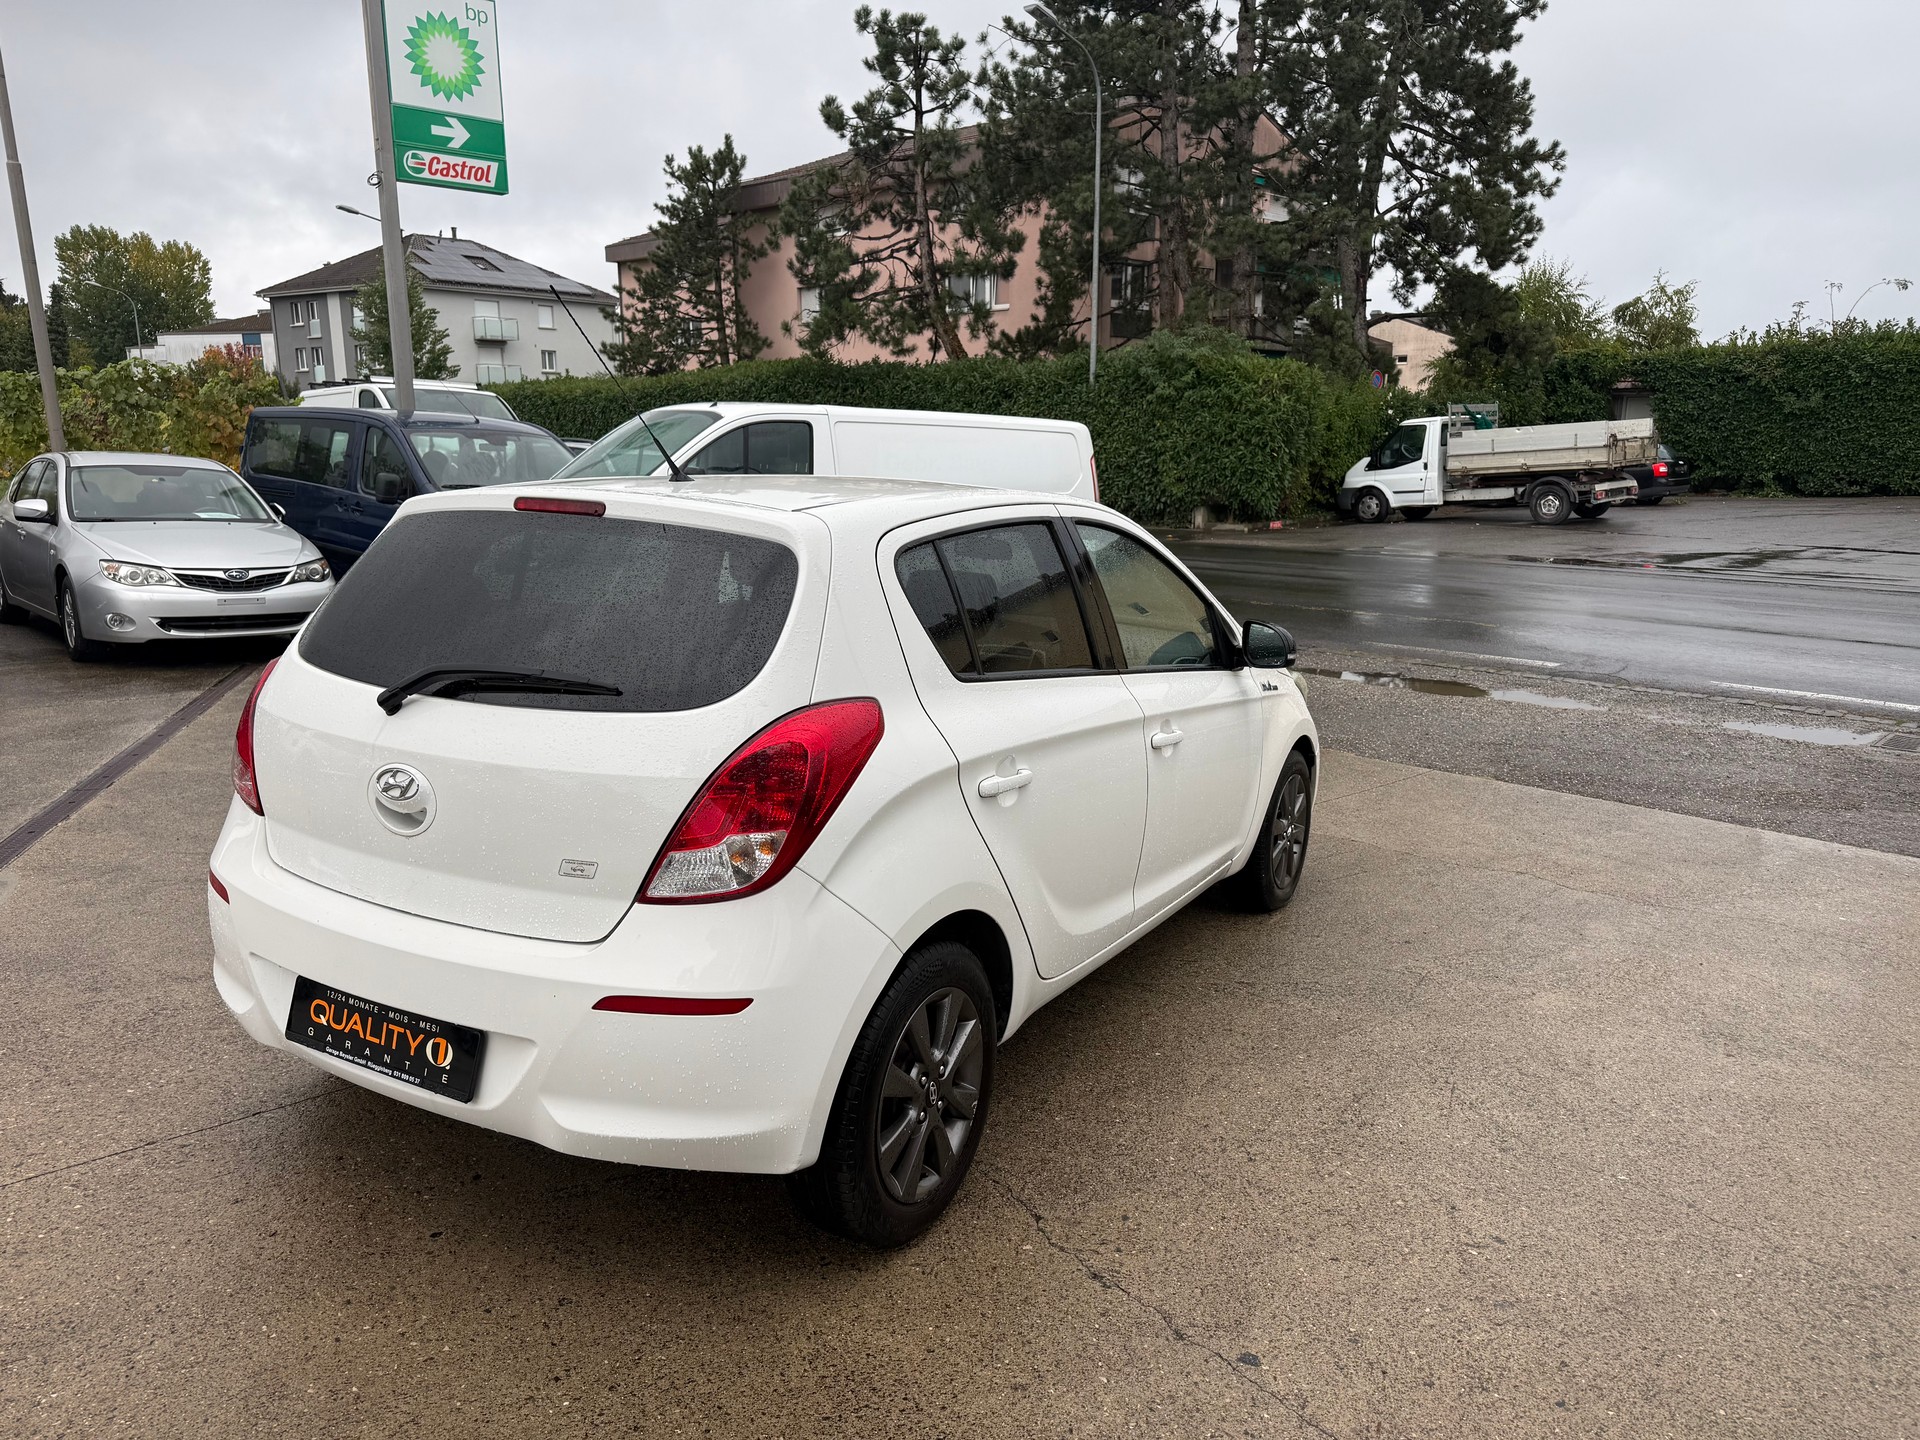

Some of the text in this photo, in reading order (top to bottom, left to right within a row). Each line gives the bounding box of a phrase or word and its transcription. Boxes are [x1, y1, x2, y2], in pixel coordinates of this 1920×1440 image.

[465, 2, 489, 27] bp
[427, 156, 492, 183] Castrol
[309, 999, 425, 1056] QUALITY
[327, 990, 346, 1002] 12/24
[348, 997, 379, 1014] MONATE
[388, 1010, 409, 1023] MOIS
[419, 1020, 440, 1033] MESI
